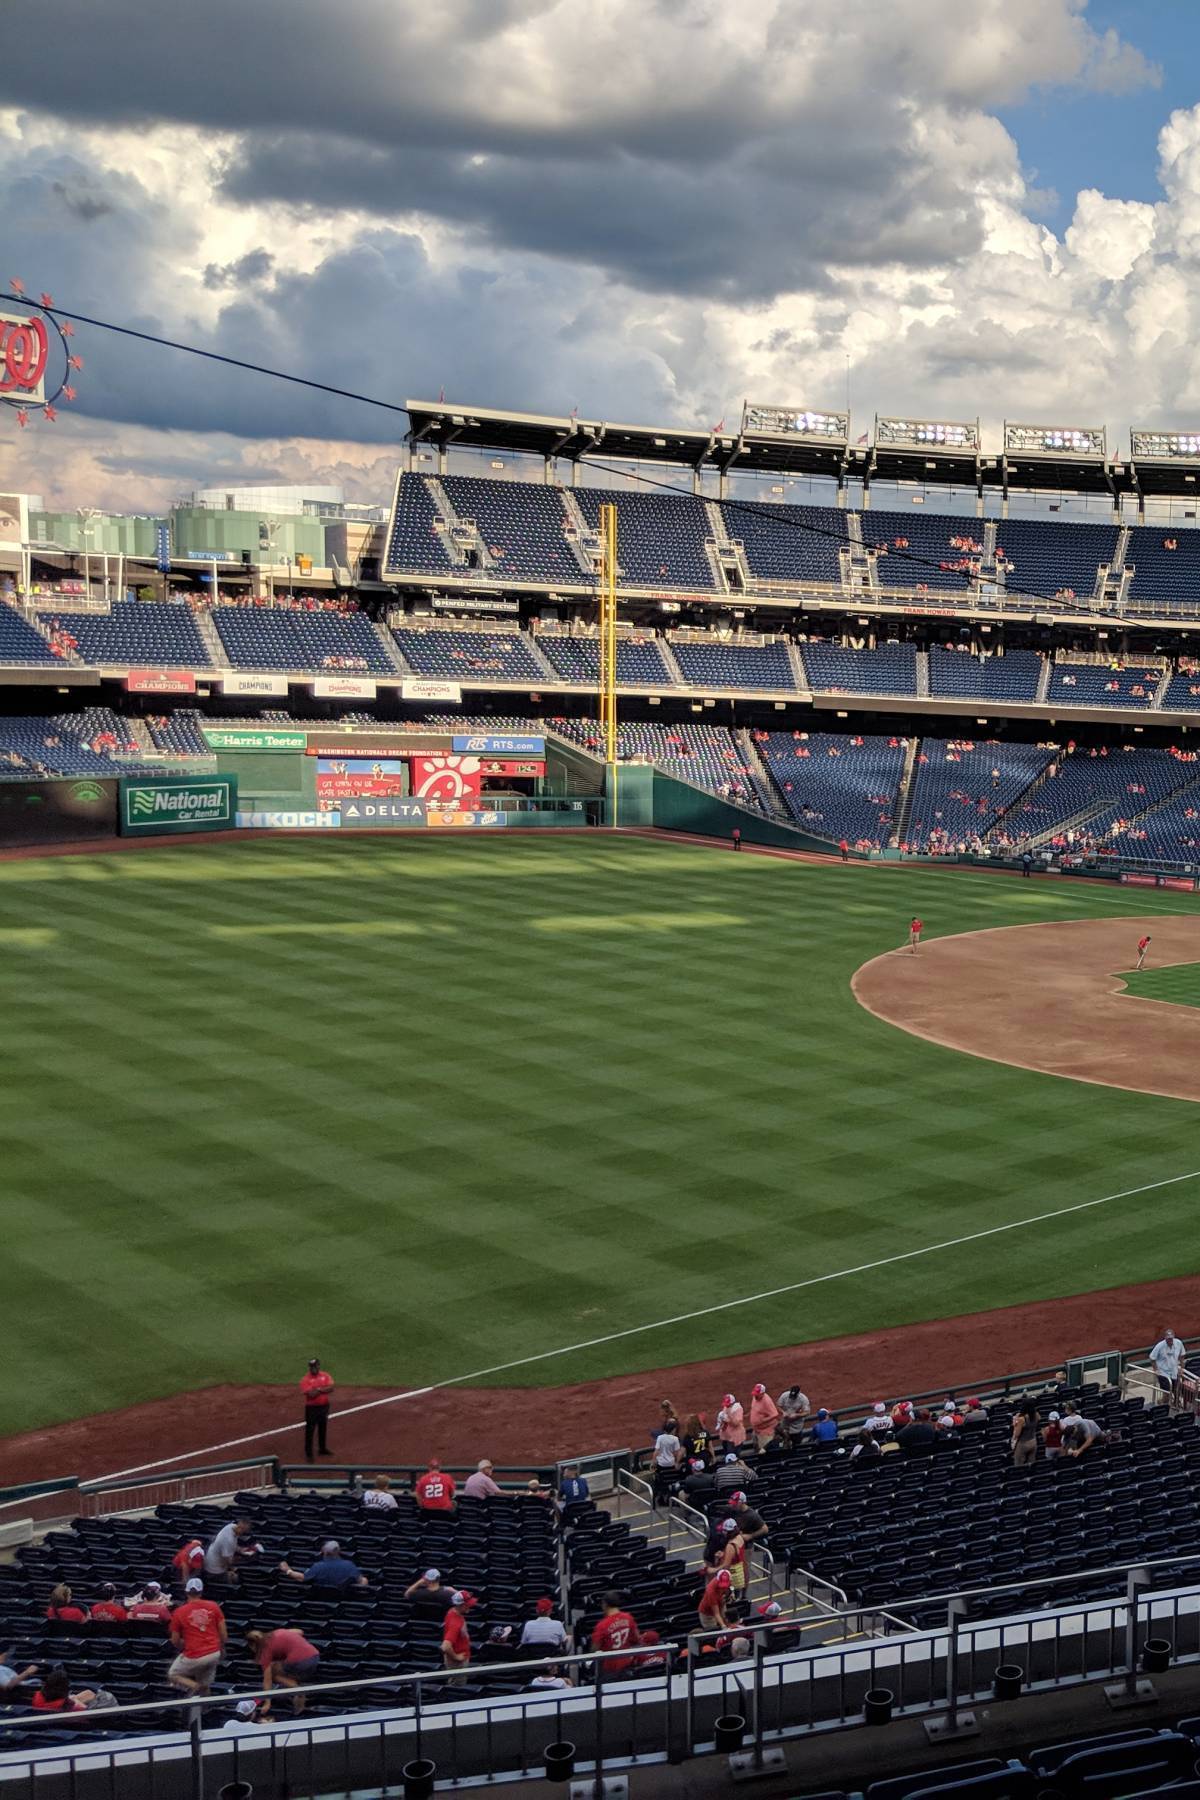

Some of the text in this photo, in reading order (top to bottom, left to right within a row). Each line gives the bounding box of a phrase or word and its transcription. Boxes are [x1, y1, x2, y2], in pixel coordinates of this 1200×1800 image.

[239, 681, 272, 691] CHAMPIONS
[329, 685, 361, 693] CHAMPIONS
[412, 685, 450, 693] CHAMPIONS
[224, 735, 303, 746] Harris Teeter
[493, 741, 534, 750] RTS.com
[178, 809, 220, 819] Car Rental
[365, 805, 422, 816] DELTA
[425, 1484, 443, 1498] 22
[611, 1628, 631, 1648] 37
